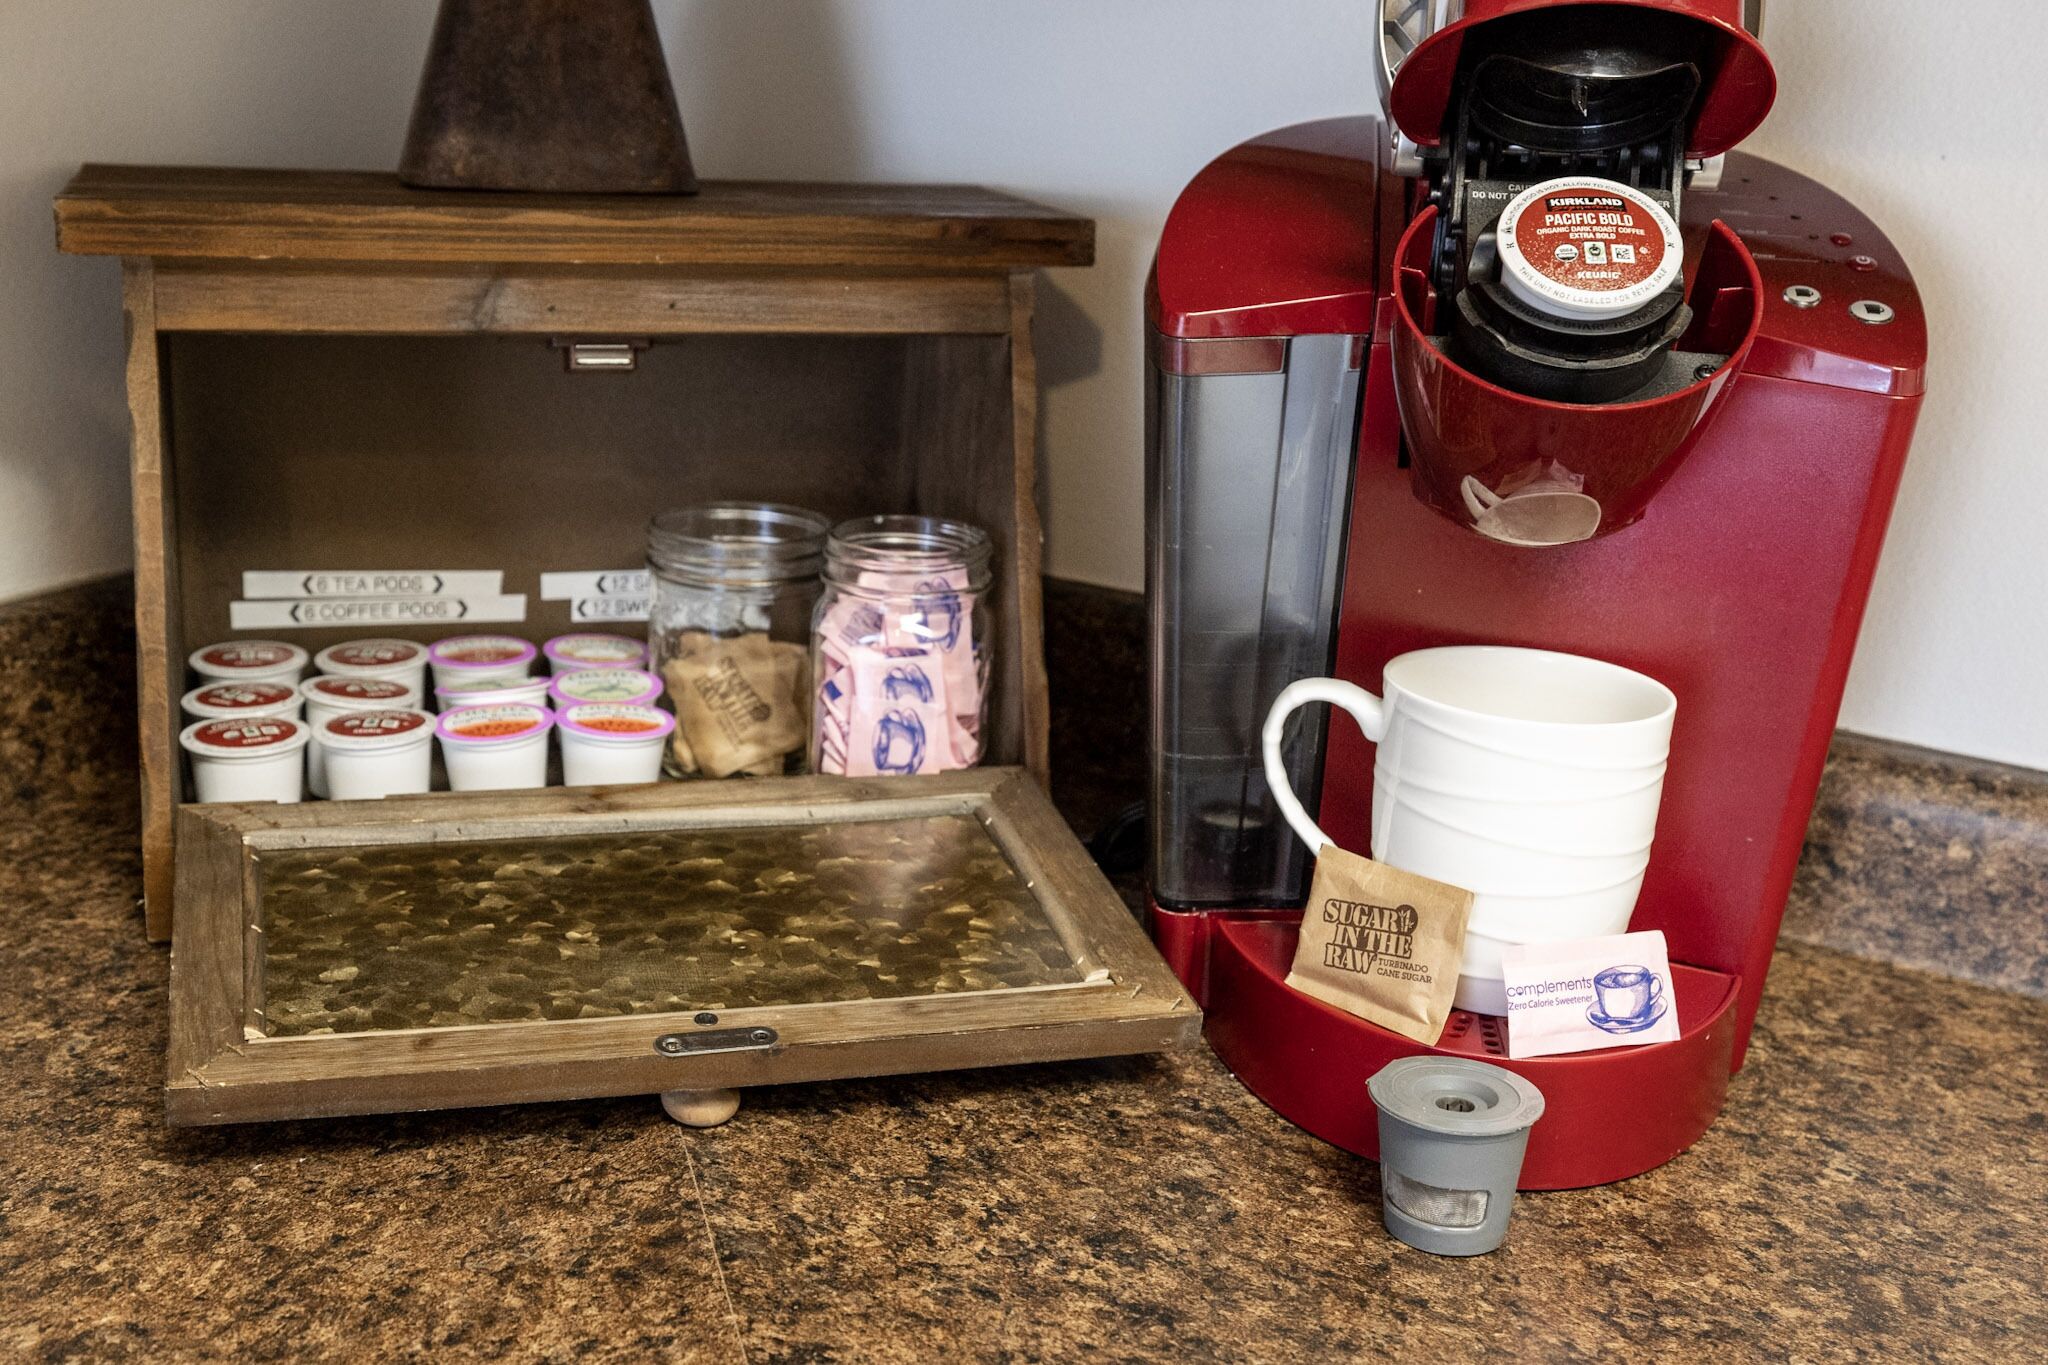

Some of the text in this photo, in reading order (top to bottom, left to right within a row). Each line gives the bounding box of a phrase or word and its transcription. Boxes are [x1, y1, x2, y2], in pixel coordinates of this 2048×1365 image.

[1472, 191, 1486, 199] DO
[1488, 192, 1508, 200] NOT
[1550, 197, 1623, 206] KIRKLAND
[1545, 212, 1634, 226] PACIFIC BOLD
[1536, 226, 1569, 235] ORGANIC
[1618, 226, 1645, 235] COFFEE
[1520, 266, 1533, 280] THIS
[1534, 281, 1551, 293] UNIT
[1553, 290, 1570, 299] NOT
[1577, 271, 1621, 279] KEURIG
[316, 575, 423, 593] 6 TEA PODS
[304, 601, 448, 621] 6 COFFEE PODS
[1323, 898, 1401, 933] SUGAR
[1333, 922, 1412, 959] IN THE
[1323, 942, 1376, 974] RAW
[1378, 958, 1429, 973] TURBINADO
[1377, 967, 1432, 984] CANE SUGAR
[1506, 976, 1592, 997] complements
[1508, 995, 1593, 1011] Zero Calorie Sweetener
